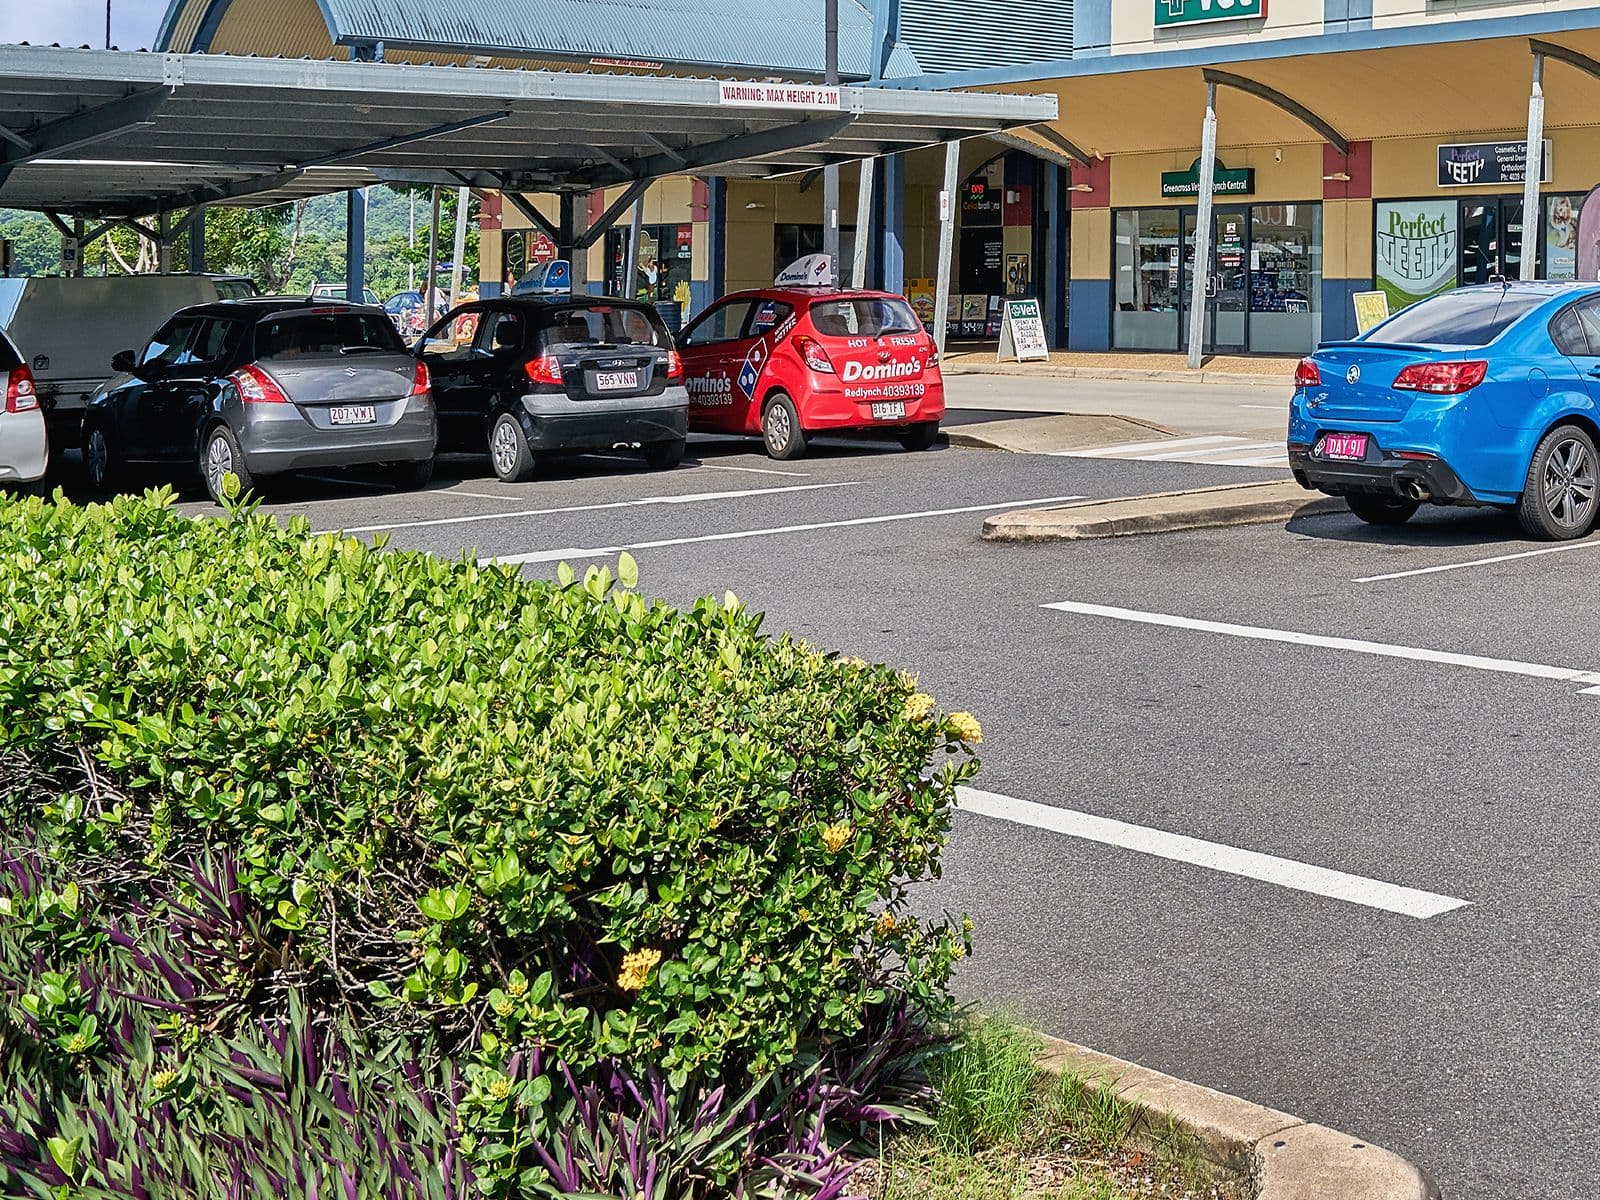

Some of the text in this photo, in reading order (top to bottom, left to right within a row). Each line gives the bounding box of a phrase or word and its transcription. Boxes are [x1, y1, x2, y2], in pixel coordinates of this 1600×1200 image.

[722, 86, 838, 105] WARNING: MAX HEIGHT 2.1M
[1451, 148, 1481, 161] Perfect
[1497, 155, 1515, 163] General
[1445, 158, 1485, 183] TEETH
[1163, 183, 1191, 193] Greencross
[1226, 180, 1247, 190] Central
[1389, 210, 1447, 238] Perfect
[1378, 230, 1456, 280] TEETH
[780, 271, 808, 282] Domino's
[1020, 304, 1037, 316] Vet
[848, 337, 917, 348] HOT & FRESH
[842, 356, 920, 382] Domino's
[685, 371, 731, 393] omino's
[845, 383, 925, 398] Redlynch 40393139
